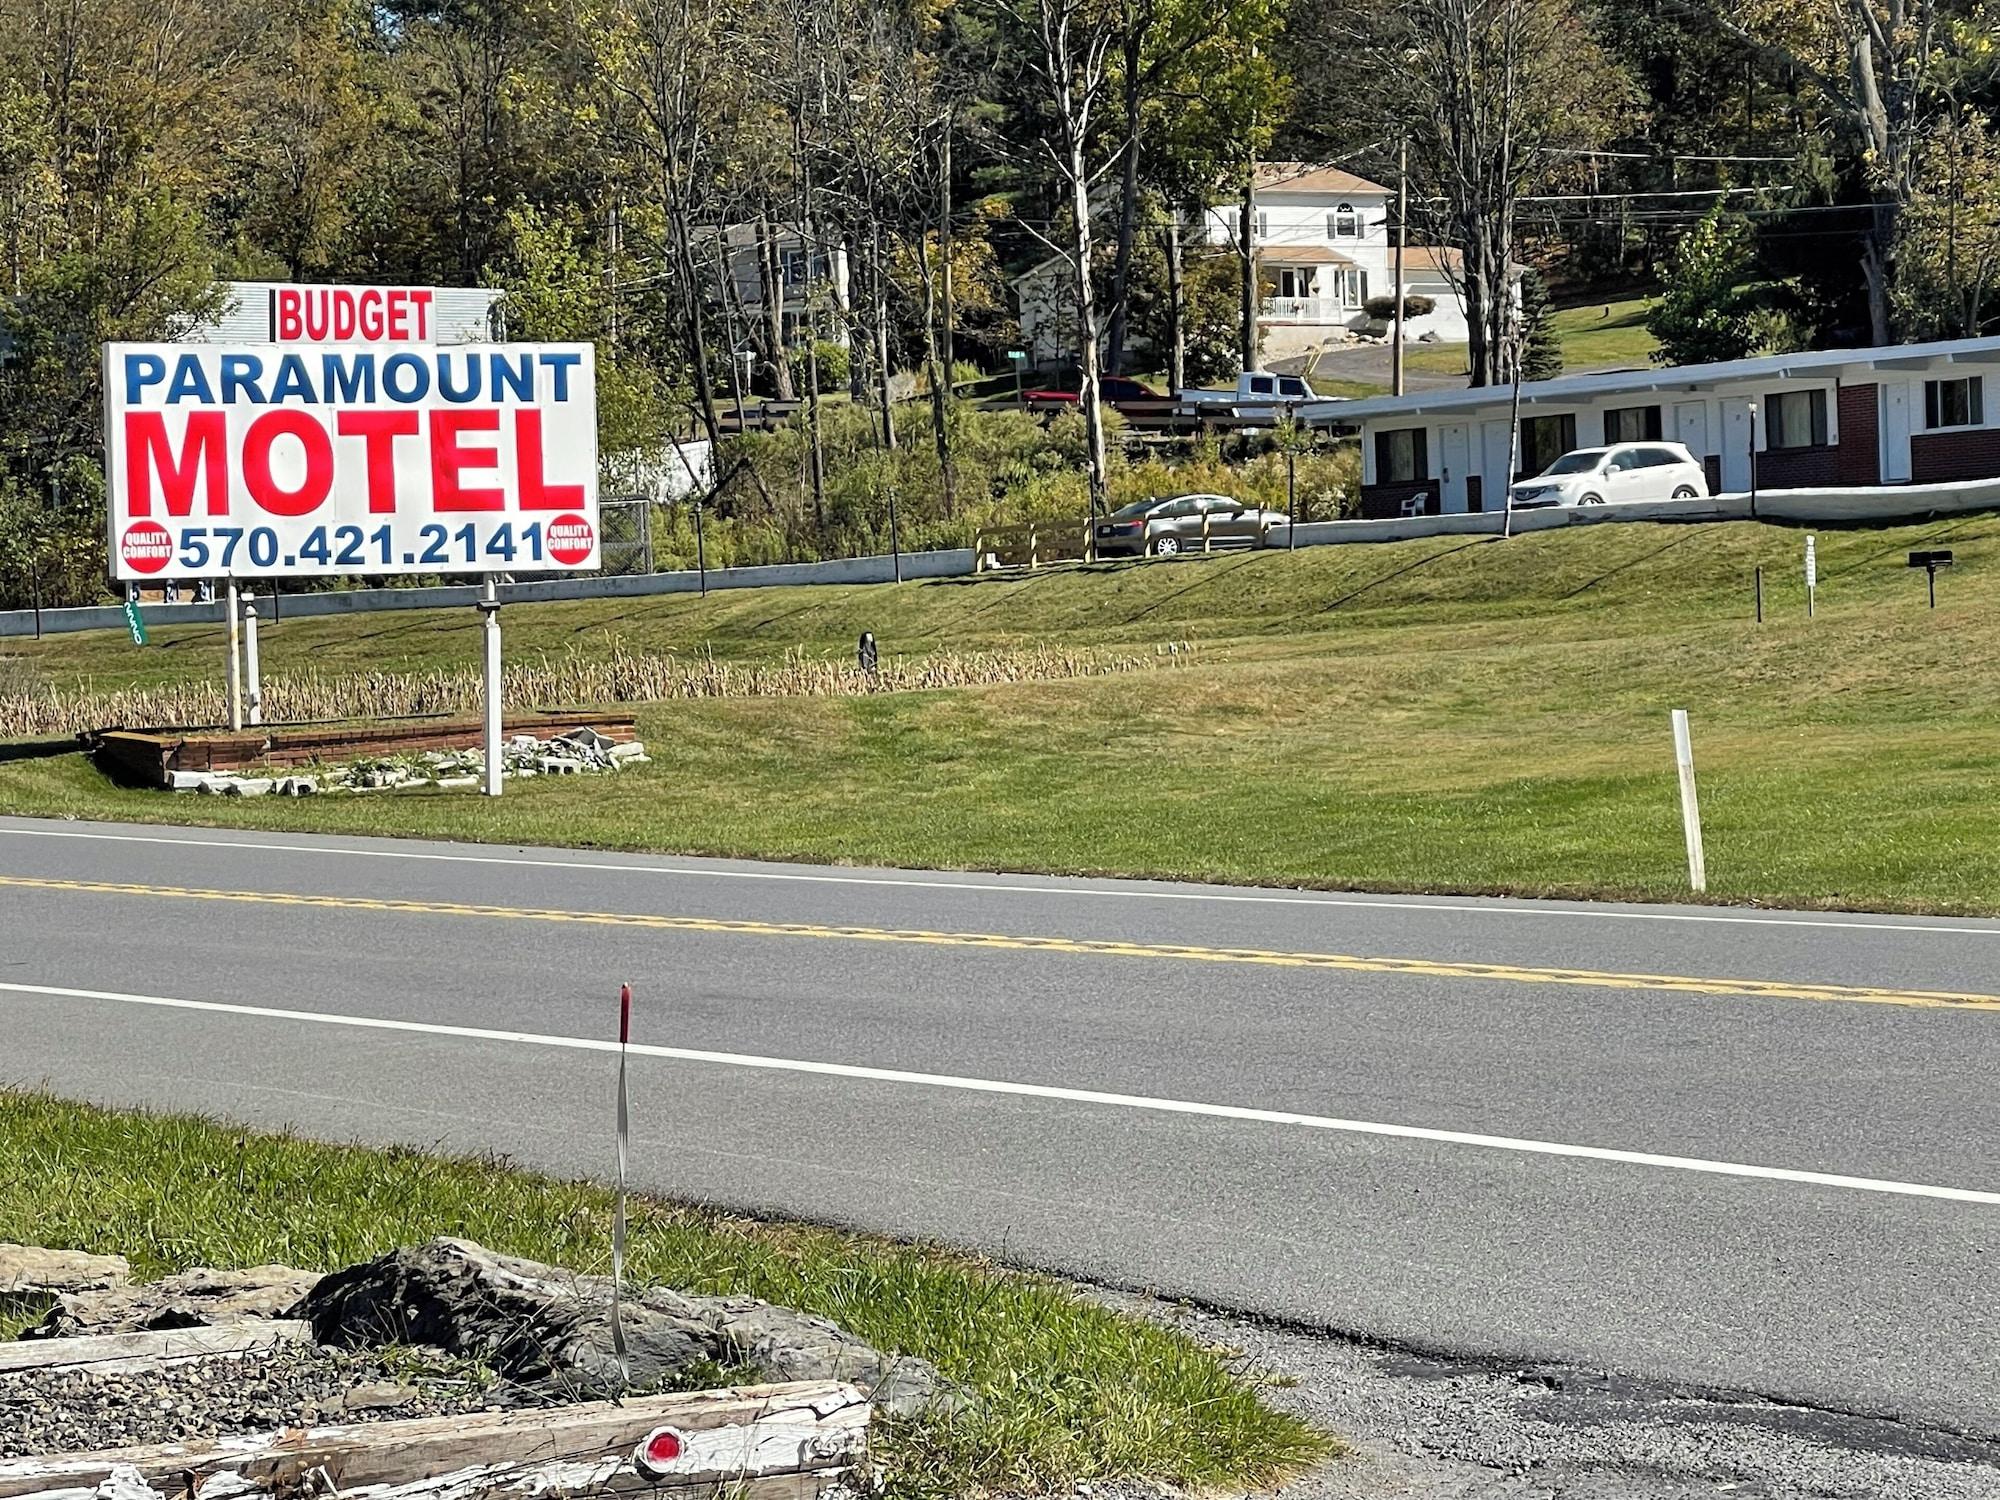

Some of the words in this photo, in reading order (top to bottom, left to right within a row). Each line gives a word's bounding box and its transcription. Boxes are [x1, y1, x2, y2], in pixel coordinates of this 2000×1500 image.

[279, 289, 433, 341] BUDGET
[124, 353, 581, 405] PARAMOUNT
[124, 408, 585, 517] MOTEL
[125, 532, 168, 545] QUALITY
[179, 522, 542, 568] 570.421.2141
[547, 537, 592, 550] COMFORT
[549, 525, 589, 538] QUALITY
[122, 545, 172, 559] COMFORT
